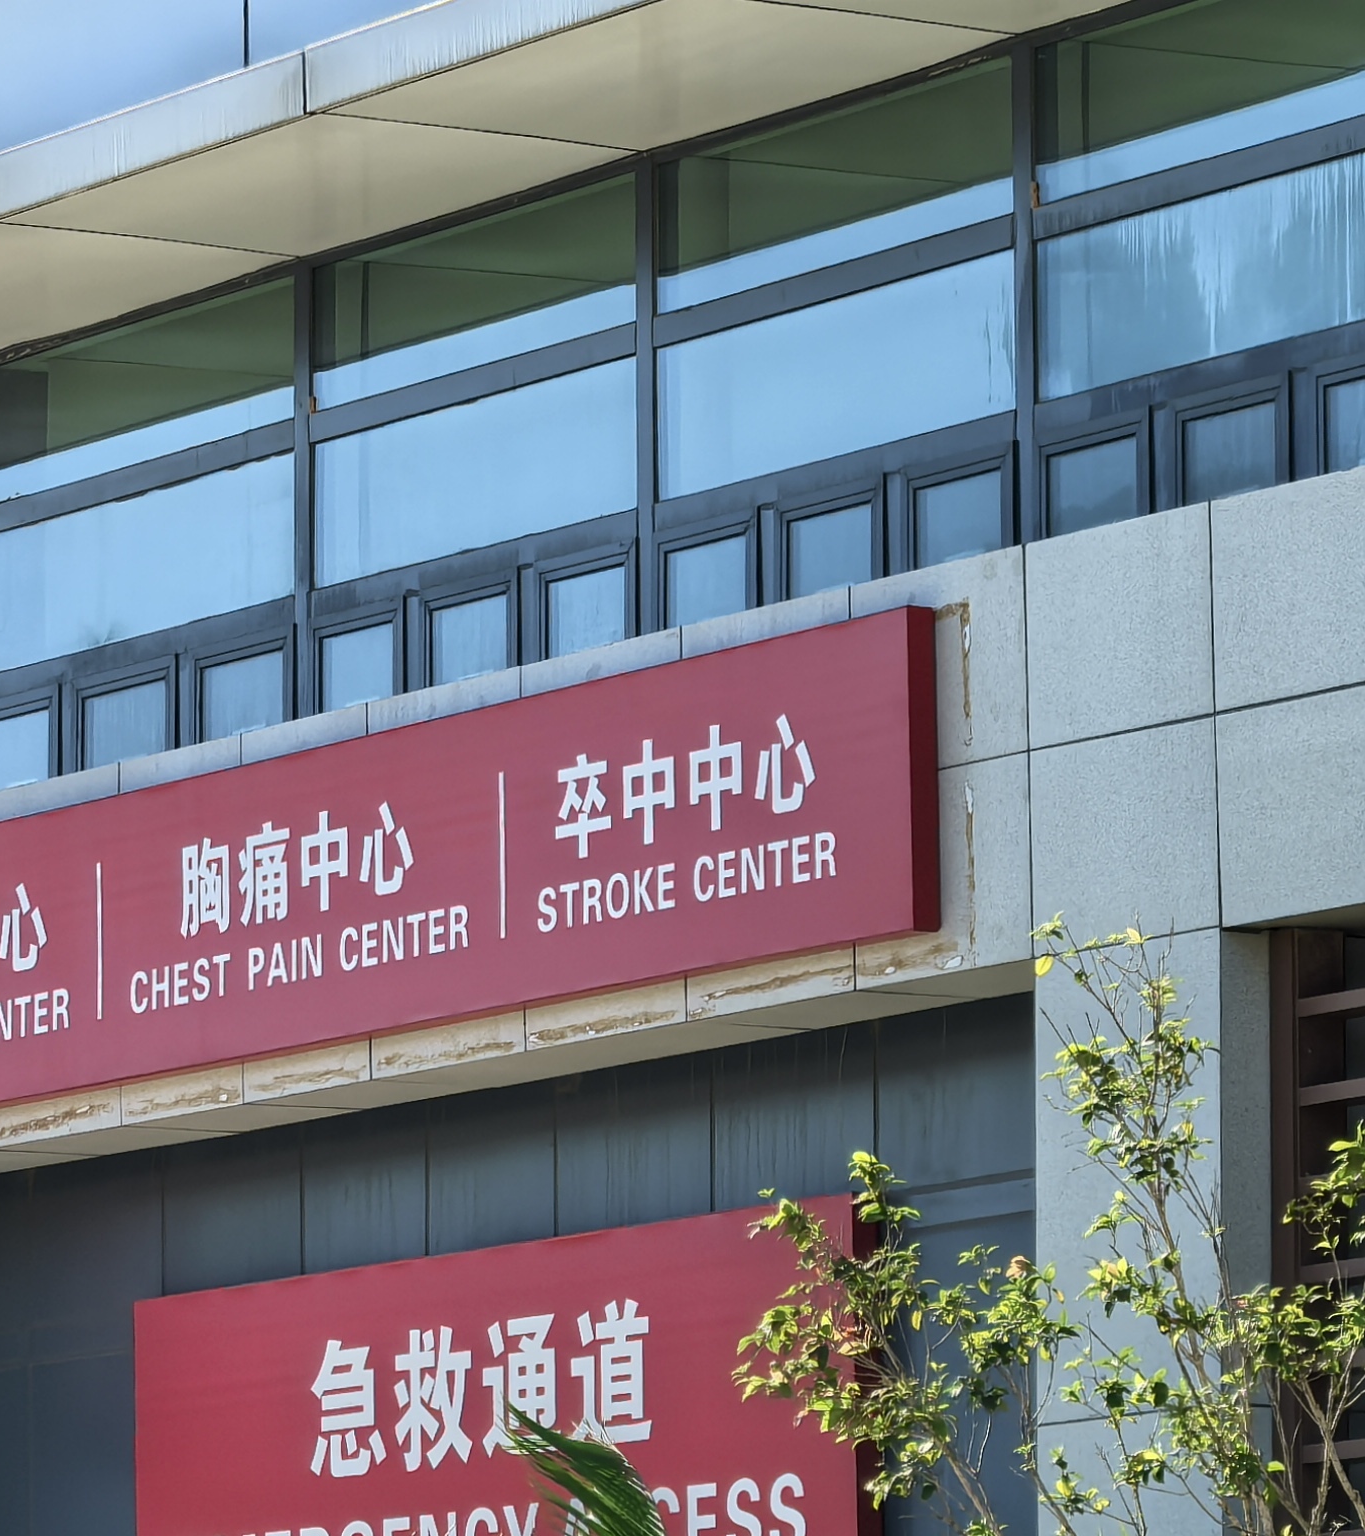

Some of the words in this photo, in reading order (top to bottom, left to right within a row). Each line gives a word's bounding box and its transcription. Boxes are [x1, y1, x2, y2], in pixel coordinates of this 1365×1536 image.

[554, 713, 816, 859] 卒中中心
[180, 802, 414, 939] 胸痛中心
[537, 862, 676, 933] STROKE
[693, 831, 837, 902] CENTER
[130, 952, 231, 1014] CHEST
[248, 933, 323, 991] PAIN
[339, 904, 469, 971] CENTER
[310, 1298, 652, 1478] 急救通道
